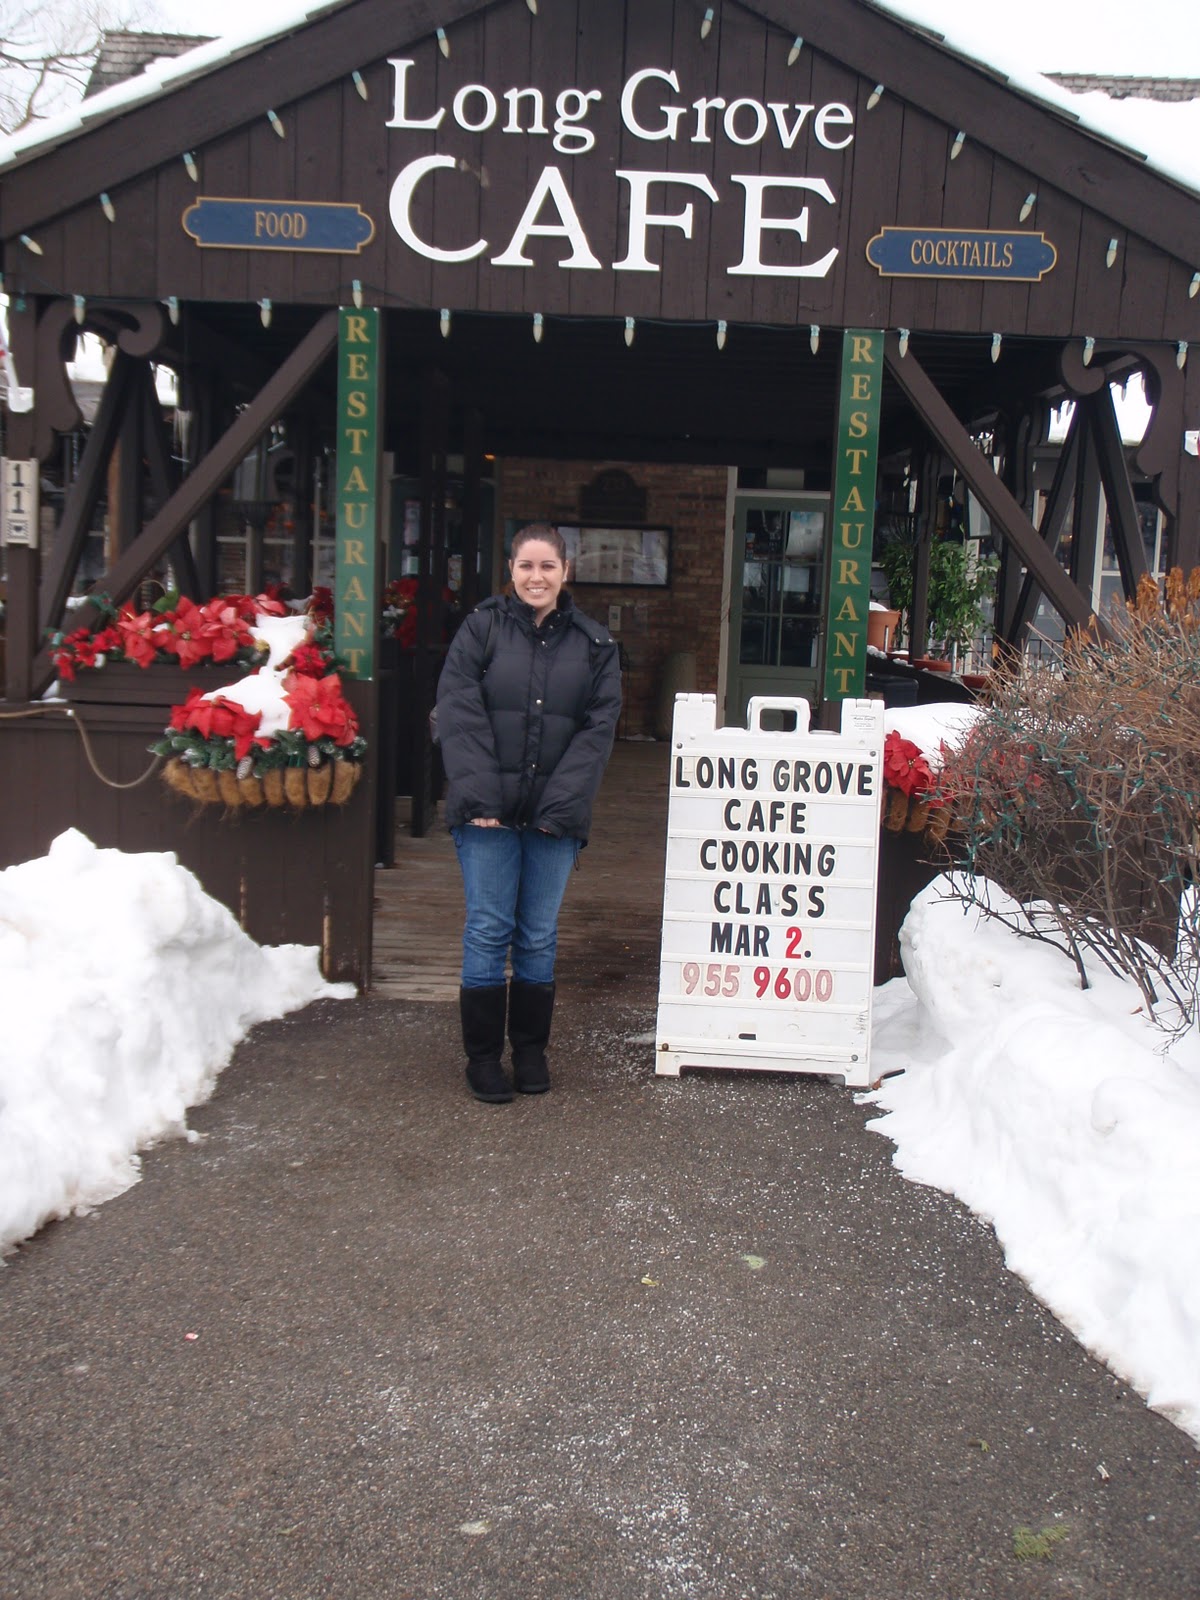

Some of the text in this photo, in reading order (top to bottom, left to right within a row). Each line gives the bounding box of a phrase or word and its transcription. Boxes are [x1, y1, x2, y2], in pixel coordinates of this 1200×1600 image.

[386, 57, 854, 154] Long Grove
[255, 211, 307, 239] FOOD
[388, 154, 840, 278] CAFE
[910, 239, 1013, 268] COCKTAILS
[342, 315, 370, 674] RESTAURANT
[833, 336, 875, 693] RESTAURANT
[675, 757, 873, 796] LONG GROVE
[724, 799, 807, 834] CAFE
[700, 839, 836, 877] COOKING
[714, 881, 825, 918] CLASS
[710, 922, 812, 959] MAR 2.
[682, 963, 833, 1001] 955 9600
